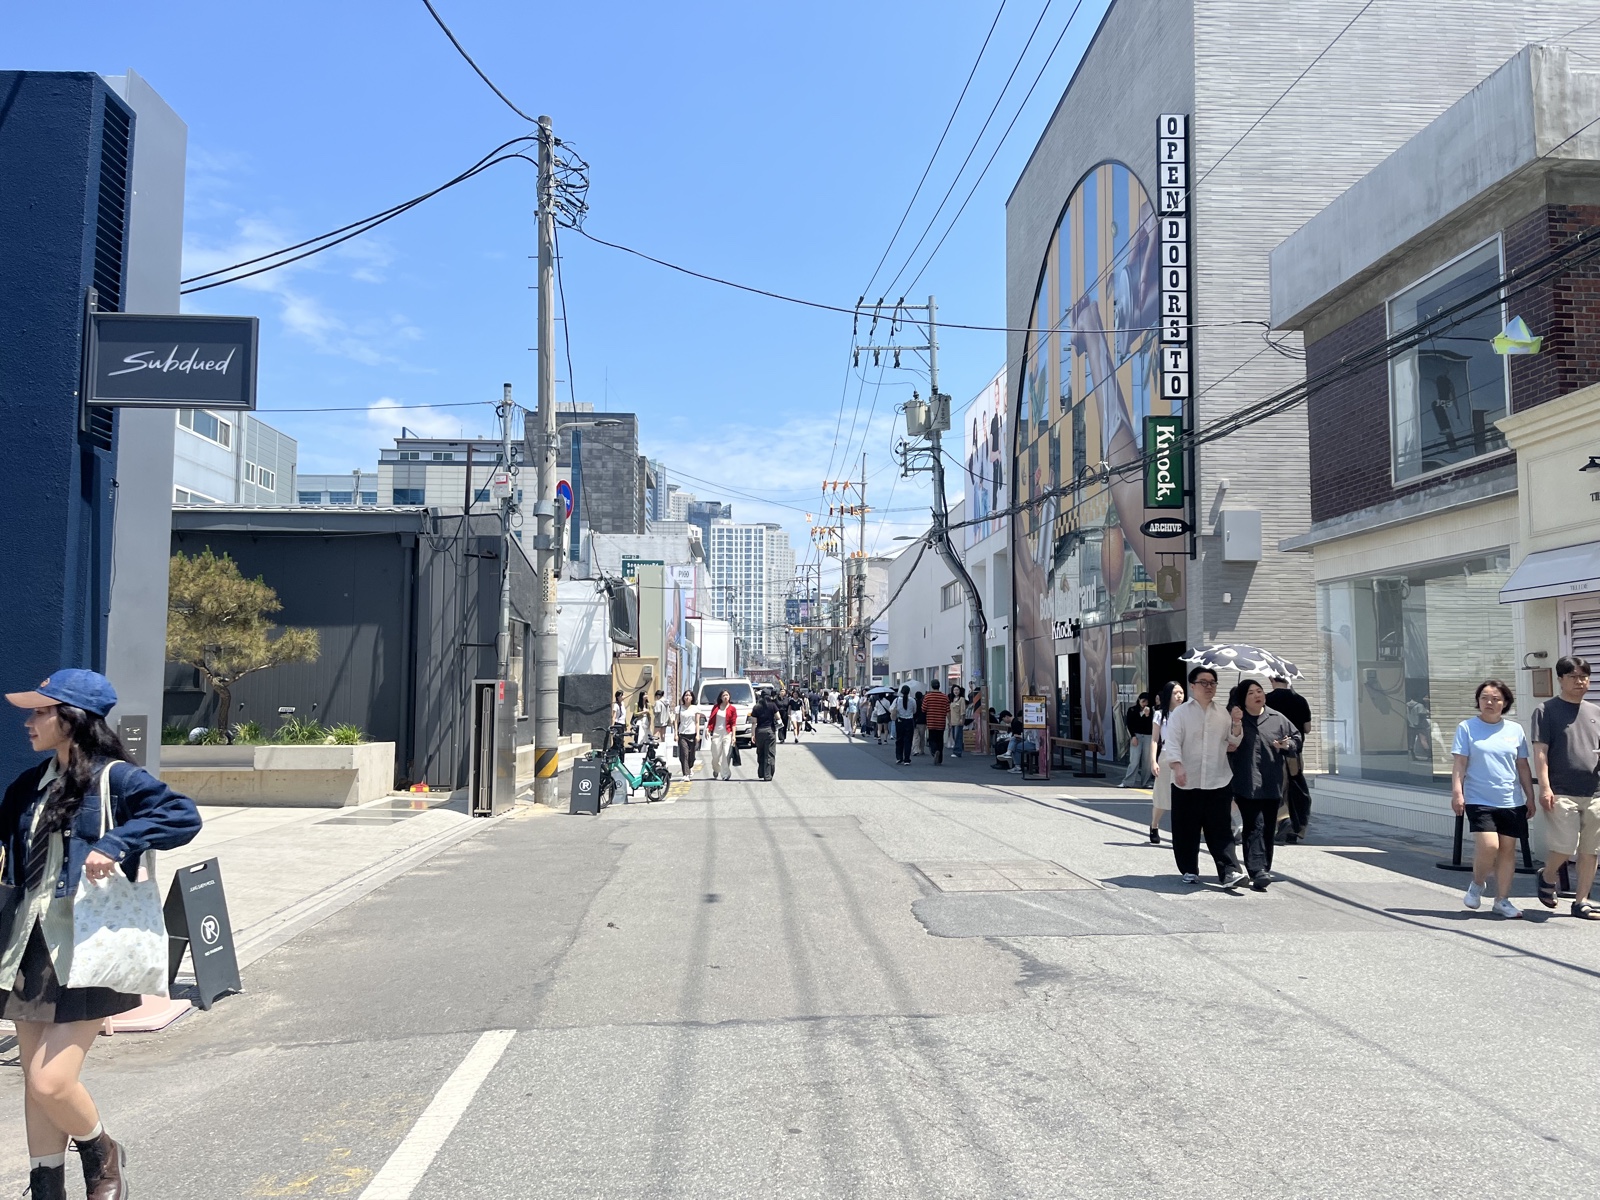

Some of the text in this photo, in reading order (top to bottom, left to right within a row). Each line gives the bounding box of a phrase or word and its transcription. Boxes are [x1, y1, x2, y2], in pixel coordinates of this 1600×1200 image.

[1166, 117, 1182, 395] OPEN DOORS TO
[107, 344, 237, 377] Subdued
[1149, 523, 1182, 533] ARCHIVE
